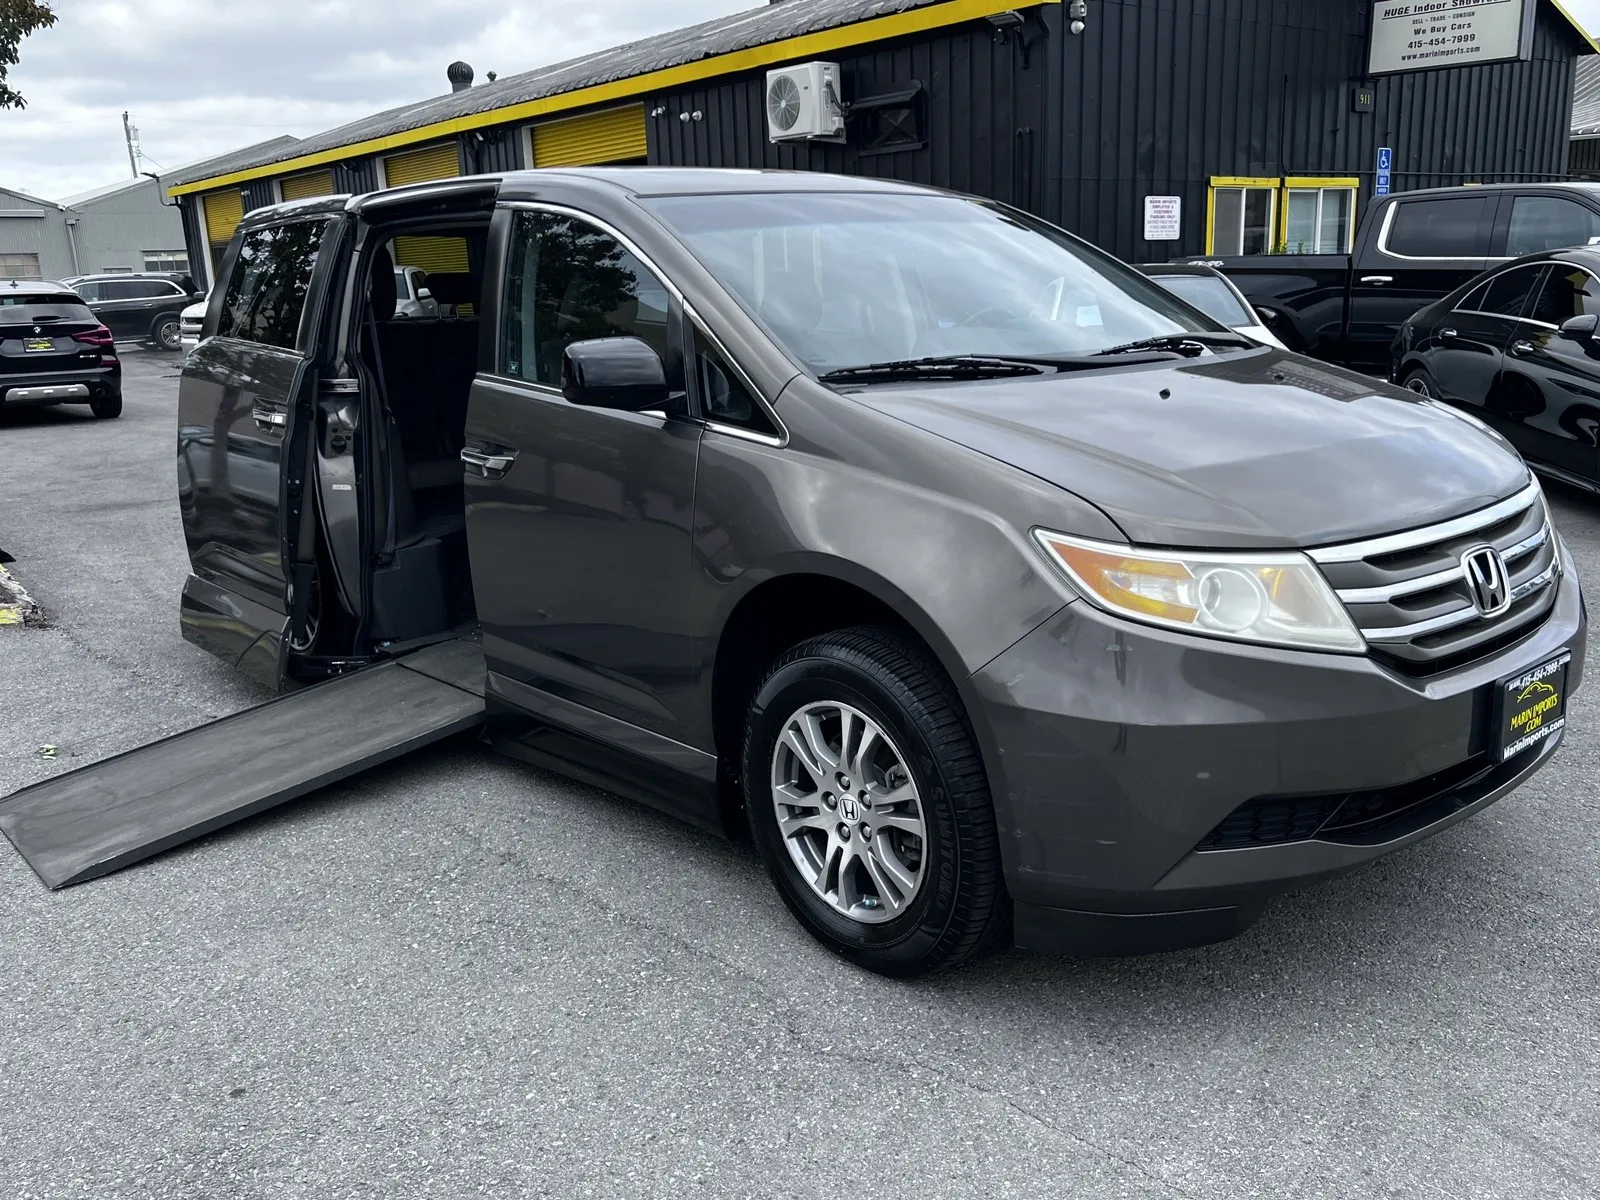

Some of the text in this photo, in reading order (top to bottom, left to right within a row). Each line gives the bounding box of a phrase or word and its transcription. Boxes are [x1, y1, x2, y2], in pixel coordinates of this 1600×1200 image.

[1383, 6, 1410, 17] HUGE
[1414, 2, 1447, 13] Indoor
[1452, 11, 1475, 19] CONSIGN
[1451, 22, 1472, 31] Cars
[1407, 33, 1476, 49] 415-454-7999
[1401, 46, 1481, 61] www.marinimports.com
[1360, 94, 1370, 104] 911
[1510, 693, 1558, 731] MARIN IMPORTS
[1524, 715, 1542, 734] .COM
[1503, 718, 1565, 760] MarinImports.com
[931, 786, 954, 911] SUMITOMO
